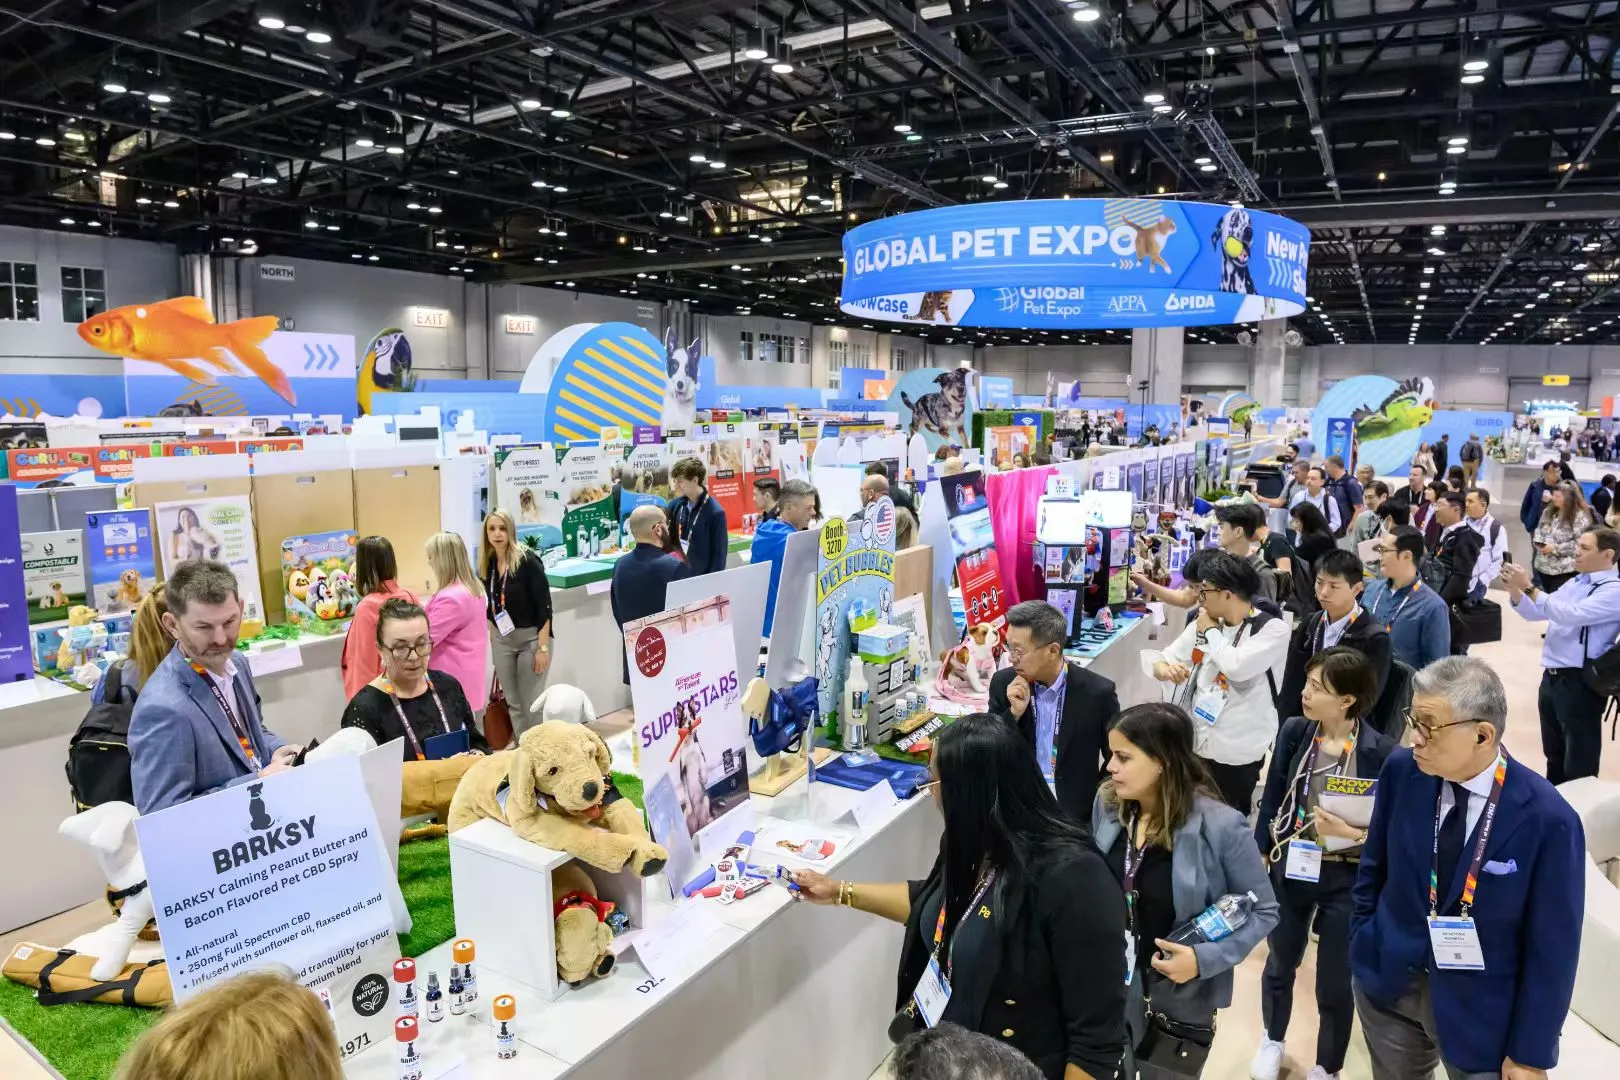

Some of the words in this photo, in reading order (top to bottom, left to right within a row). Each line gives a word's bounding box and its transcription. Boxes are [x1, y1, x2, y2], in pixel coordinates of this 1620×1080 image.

[854, 235, 947, 275] GLOBAL
[952, 227, 1021, 259] PET
[1028, 225, 1137, 256] EXPO
[1266, 231, 1298, 262] New
[261, 267, 294, 277] NORTH
[1020, 287, 1084, 300] Global
[1180, 295, 1215, 310] PIDA
[1023, 301, 1045, 315] Pet
[1046, 301, 1081, 319] Expo
[1108, 296, 1147, 312] APPA
[416, 312, 444, 325] EXIT
[508, 319, 531, 332] EXIT
[633, 459, 660, 469] HYDRO
[825, 522, 844, 540] Booth
[826, 539, 842, 556] 3270
[25, 557, 76, 569] COMPOSTABLE
[820, 560, 843, 595] PET
[845, 552, 893, 576] BUBBLES
[684, 678, 700, 690] Talent
[641, 671, 738, 749] SUPSTARS
[1326, 784, 1367, 795] DAILY
[1327, 777, 1374, 788] SHOW
[212, 815, 316, 875] BARKSY
[164, 888, 215, 917] BARKSY
[219, 868, 268, 895] Calming
[270, 851, 311, 874] Peanut
[312, 838, 346, 858] Butter
[349, 828, 368, 844] and
[184, 906, 225, 929] Bacon
[227, 881, 279, 911] Flavored
[281, 874, 301, 888] Pet
[302, 862, 327, 879] CBD
[328, 850, 359, 869] Spray
[185, 929, 239, 959] All-natural
[188, 951, 224, 973] 250mg
[224, 942, 243, 957] Full
[244, 922, 290, 948] Spectrum
[291, 911, 311, 926] CBD
[191, 963, 229, 987] Infused
[230, 953, 252, 968] with
[253, 931, 299, 958] sunflower
[300, 925, 315, 936] oil,
[315, 906, 351, 929] flaxseed
[352, 901, 366, 911] oil,
[366, 892, 382, 906] and
[294, 968, 307, 980] nd
[308, 946, 355, 974] tranquility
[356, 940, 369, 950] for
[370, 928, 390, 944] your
[336, 956, 362, 974] blend
[356, 983, 385, 1002] NATURAL
[361, 979, 378, 992] 100%
